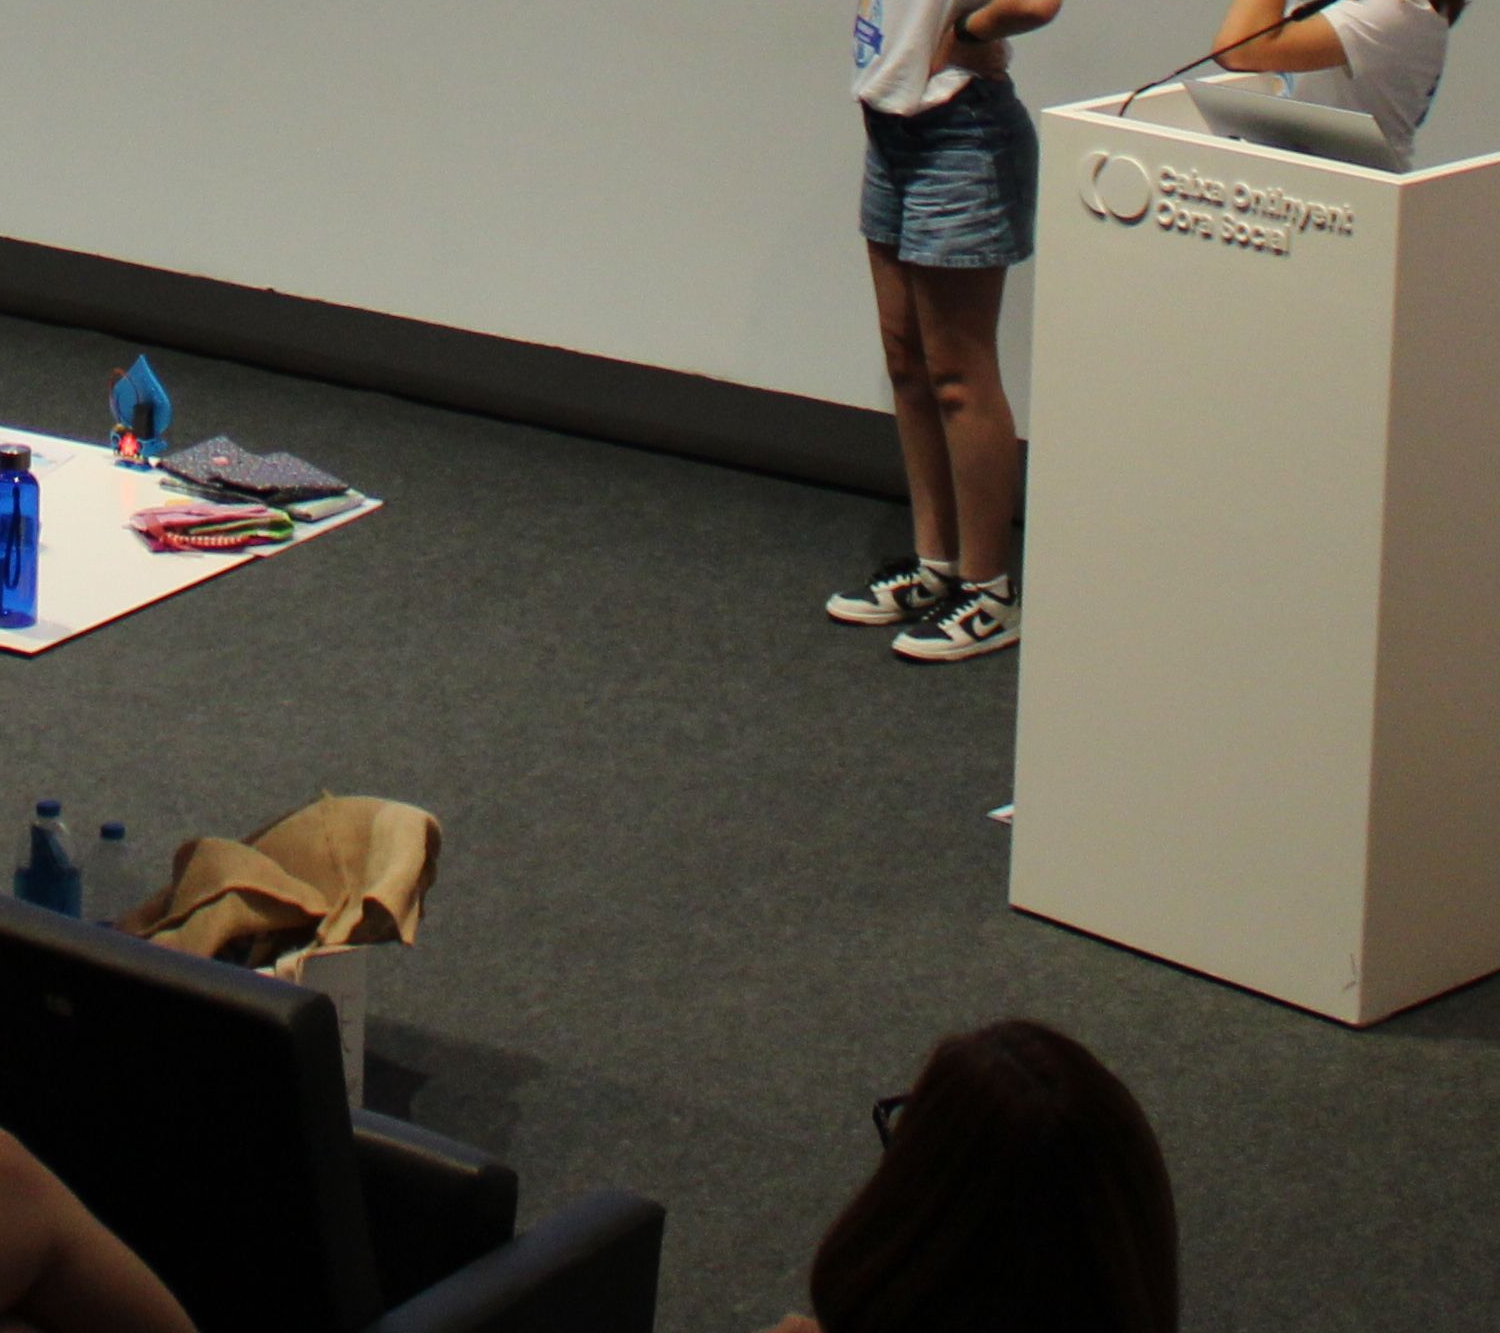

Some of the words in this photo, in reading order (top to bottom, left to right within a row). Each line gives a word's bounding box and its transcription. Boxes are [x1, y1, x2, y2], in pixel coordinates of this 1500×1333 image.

[1156, 199, 1214, 239] Obra
[1221, 212, 1292, 256] Social
[1159, 165, 1226, 207] Caixa
[1233, 181, 1354, 235] Ontinyent
